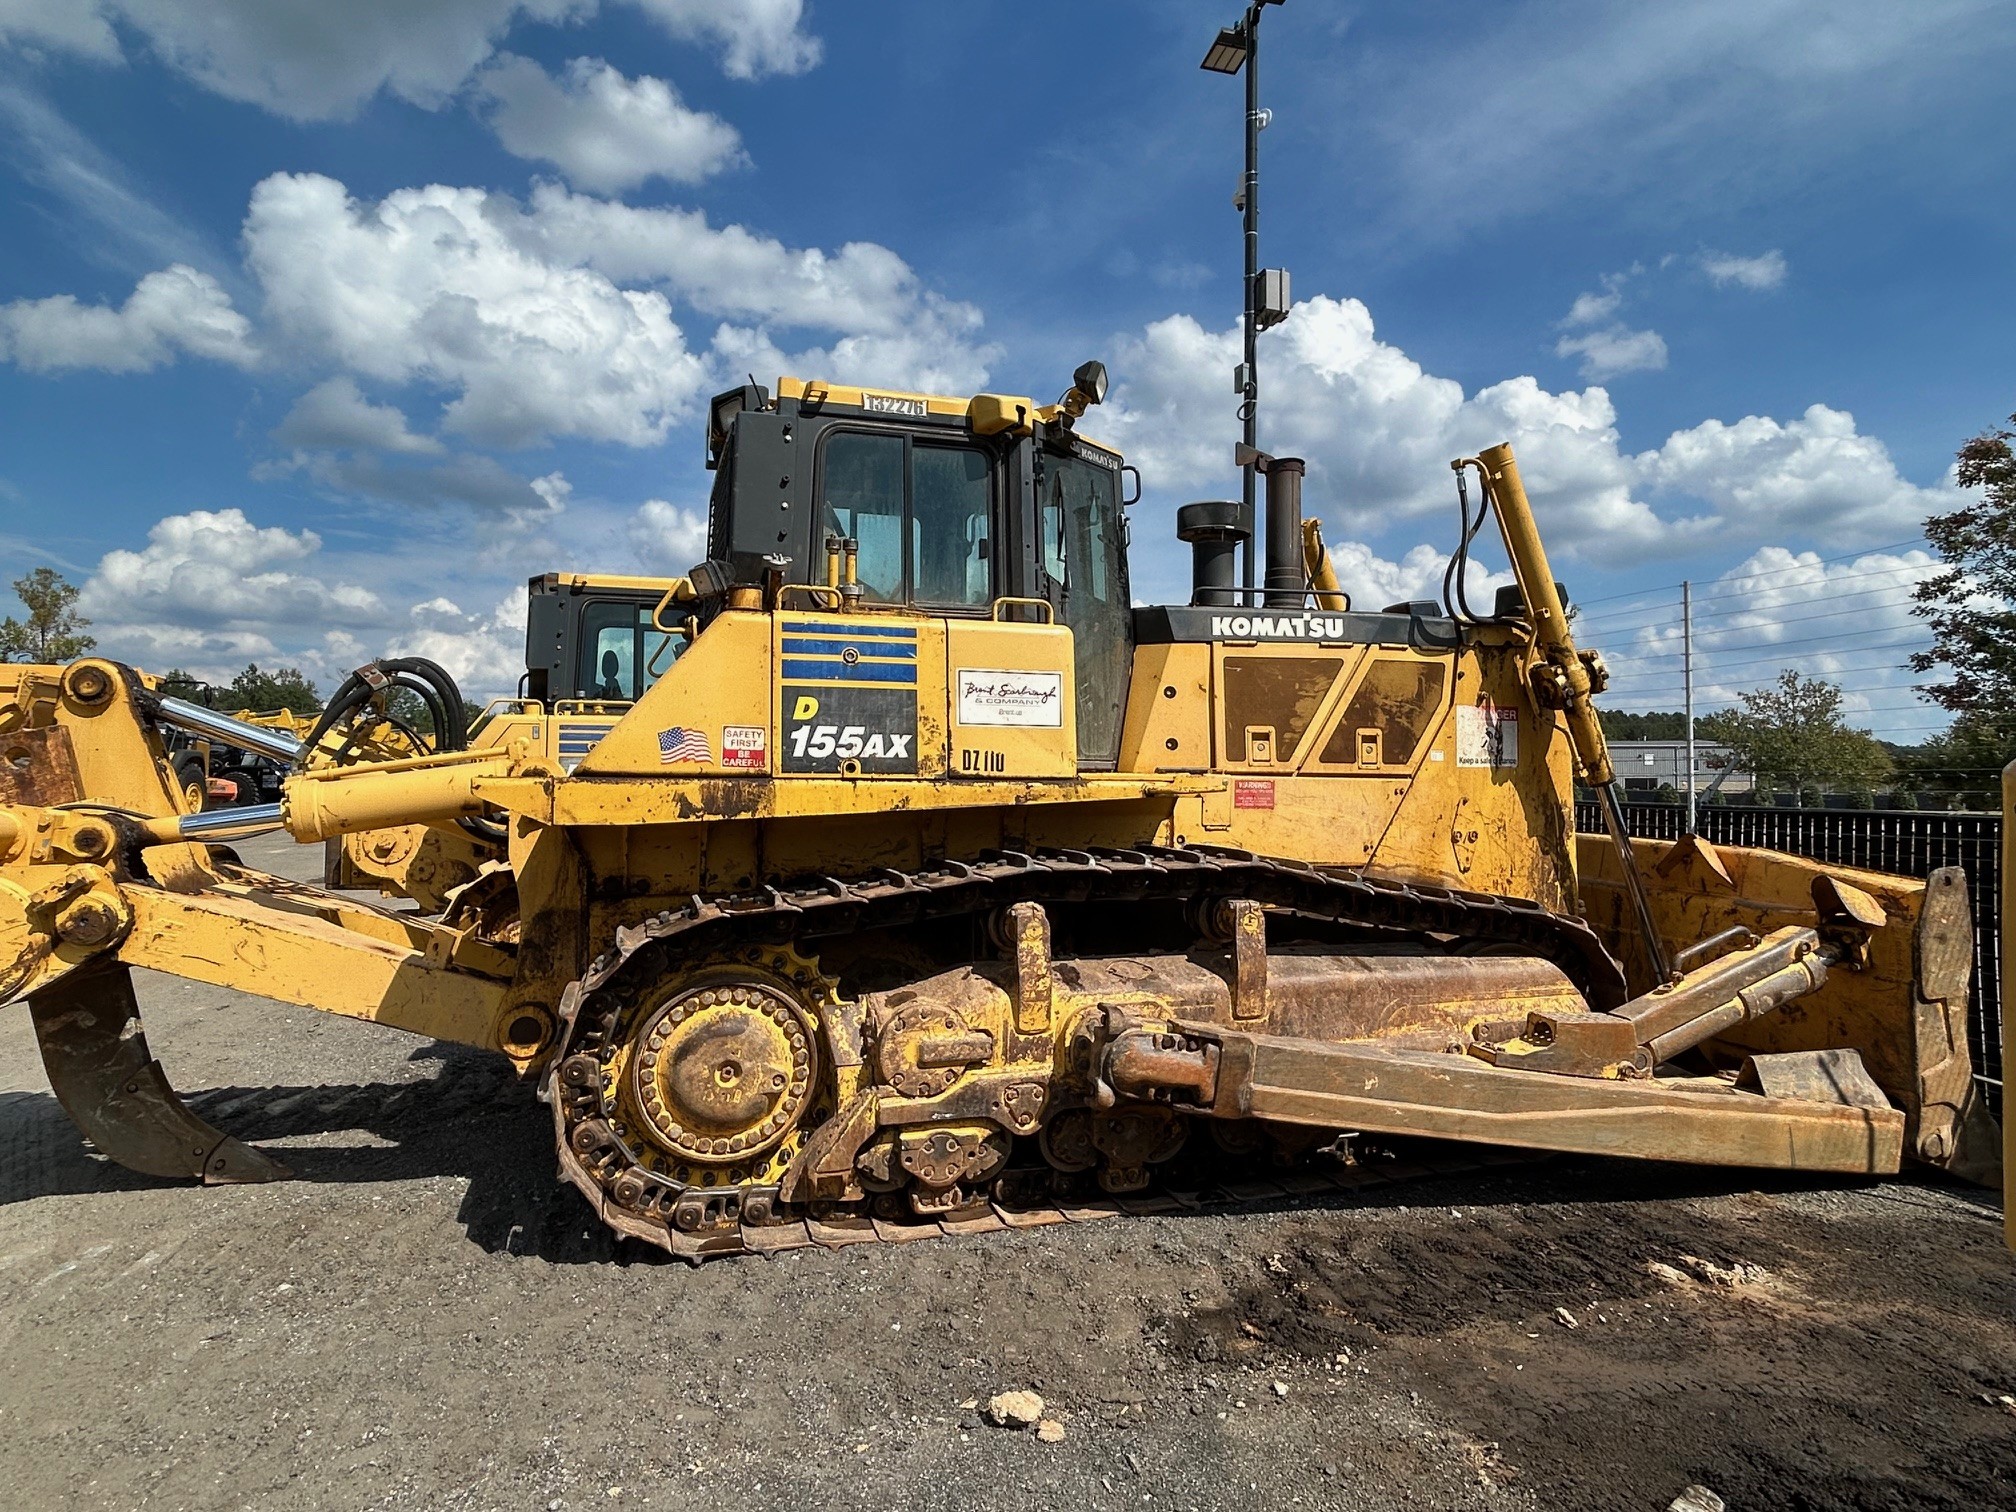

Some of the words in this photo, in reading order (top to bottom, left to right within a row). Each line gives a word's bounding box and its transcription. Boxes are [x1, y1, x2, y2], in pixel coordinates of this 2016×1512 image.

[867, 396, 924, 414] 132276
[1081, 447, 1118, 470] KOMATSU
[1212, 612, 1344, 638] KOMATSU
[792, 696, 819, 720] D
[726, 730, 762, 738] SAFETY
[730, 739, 757, 748] FIRST
[790, 725, 913, 758] 155AX
[737, 750, 751, 759] BE
[1459, 757, 1475, 766] Keep
[722, 757, 764, 767] CAREFUL
